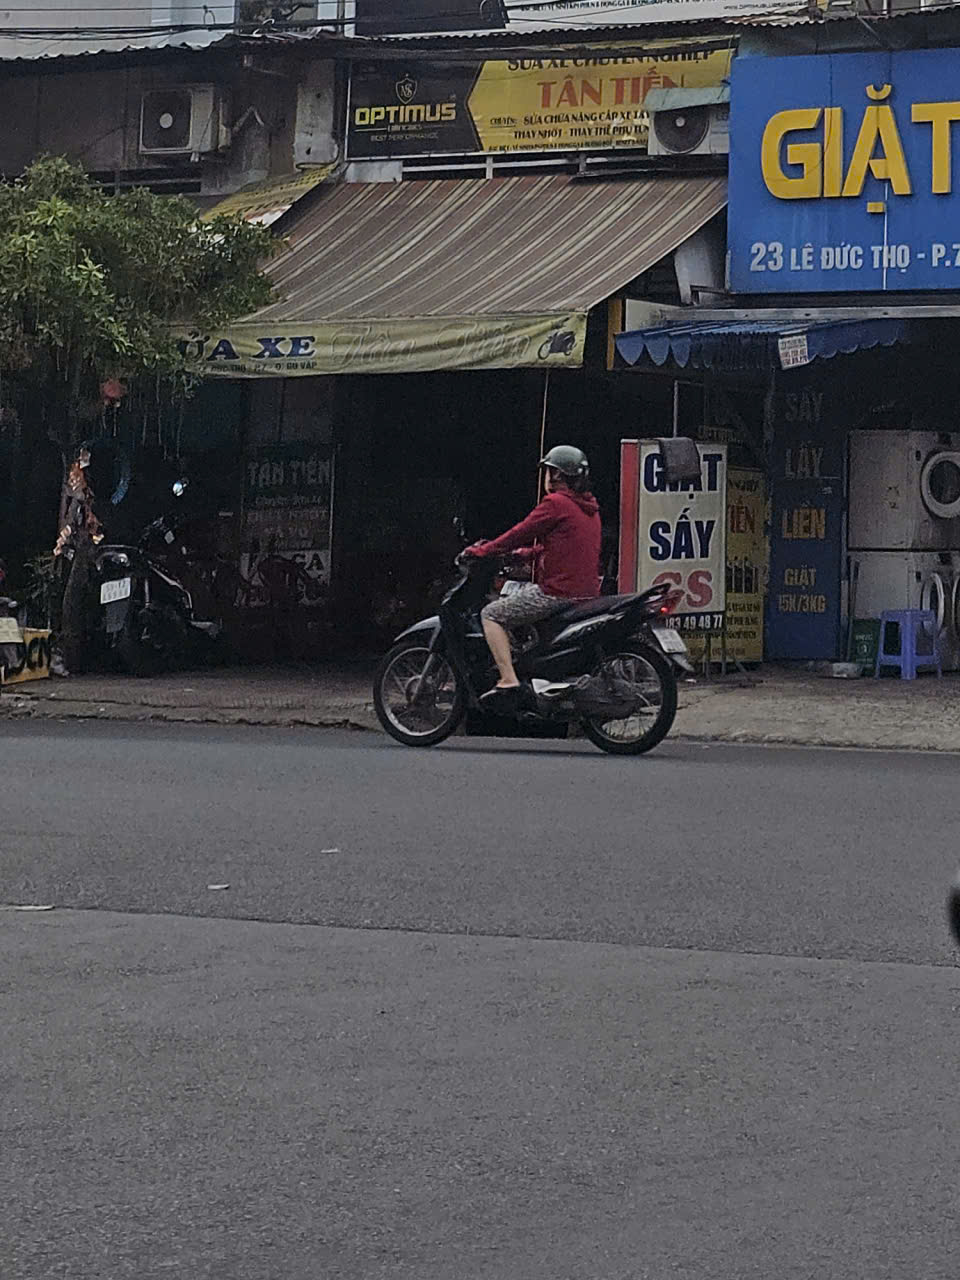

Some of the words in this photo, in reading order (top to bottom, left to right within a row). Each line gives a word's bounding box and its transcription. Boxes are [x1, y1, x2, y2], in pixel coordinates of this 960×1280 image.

[537, 74, 602, 108] TÂN
[355, 102, 456, 126] OPTIMUS
[751, 242, 784, 271] 23
[790, 243, 813, 270] LÊ
[821, 242, 863, 269] ĐỨC
[871, 244, 910, 273] THỌ
[251, 335, 316, 359] XE
[649, 508, 717, 561] SẤY
[683, 615, 697, 630] 49
[698, 613, 711, 629] 48
[713, 613, 723, 629] 77
